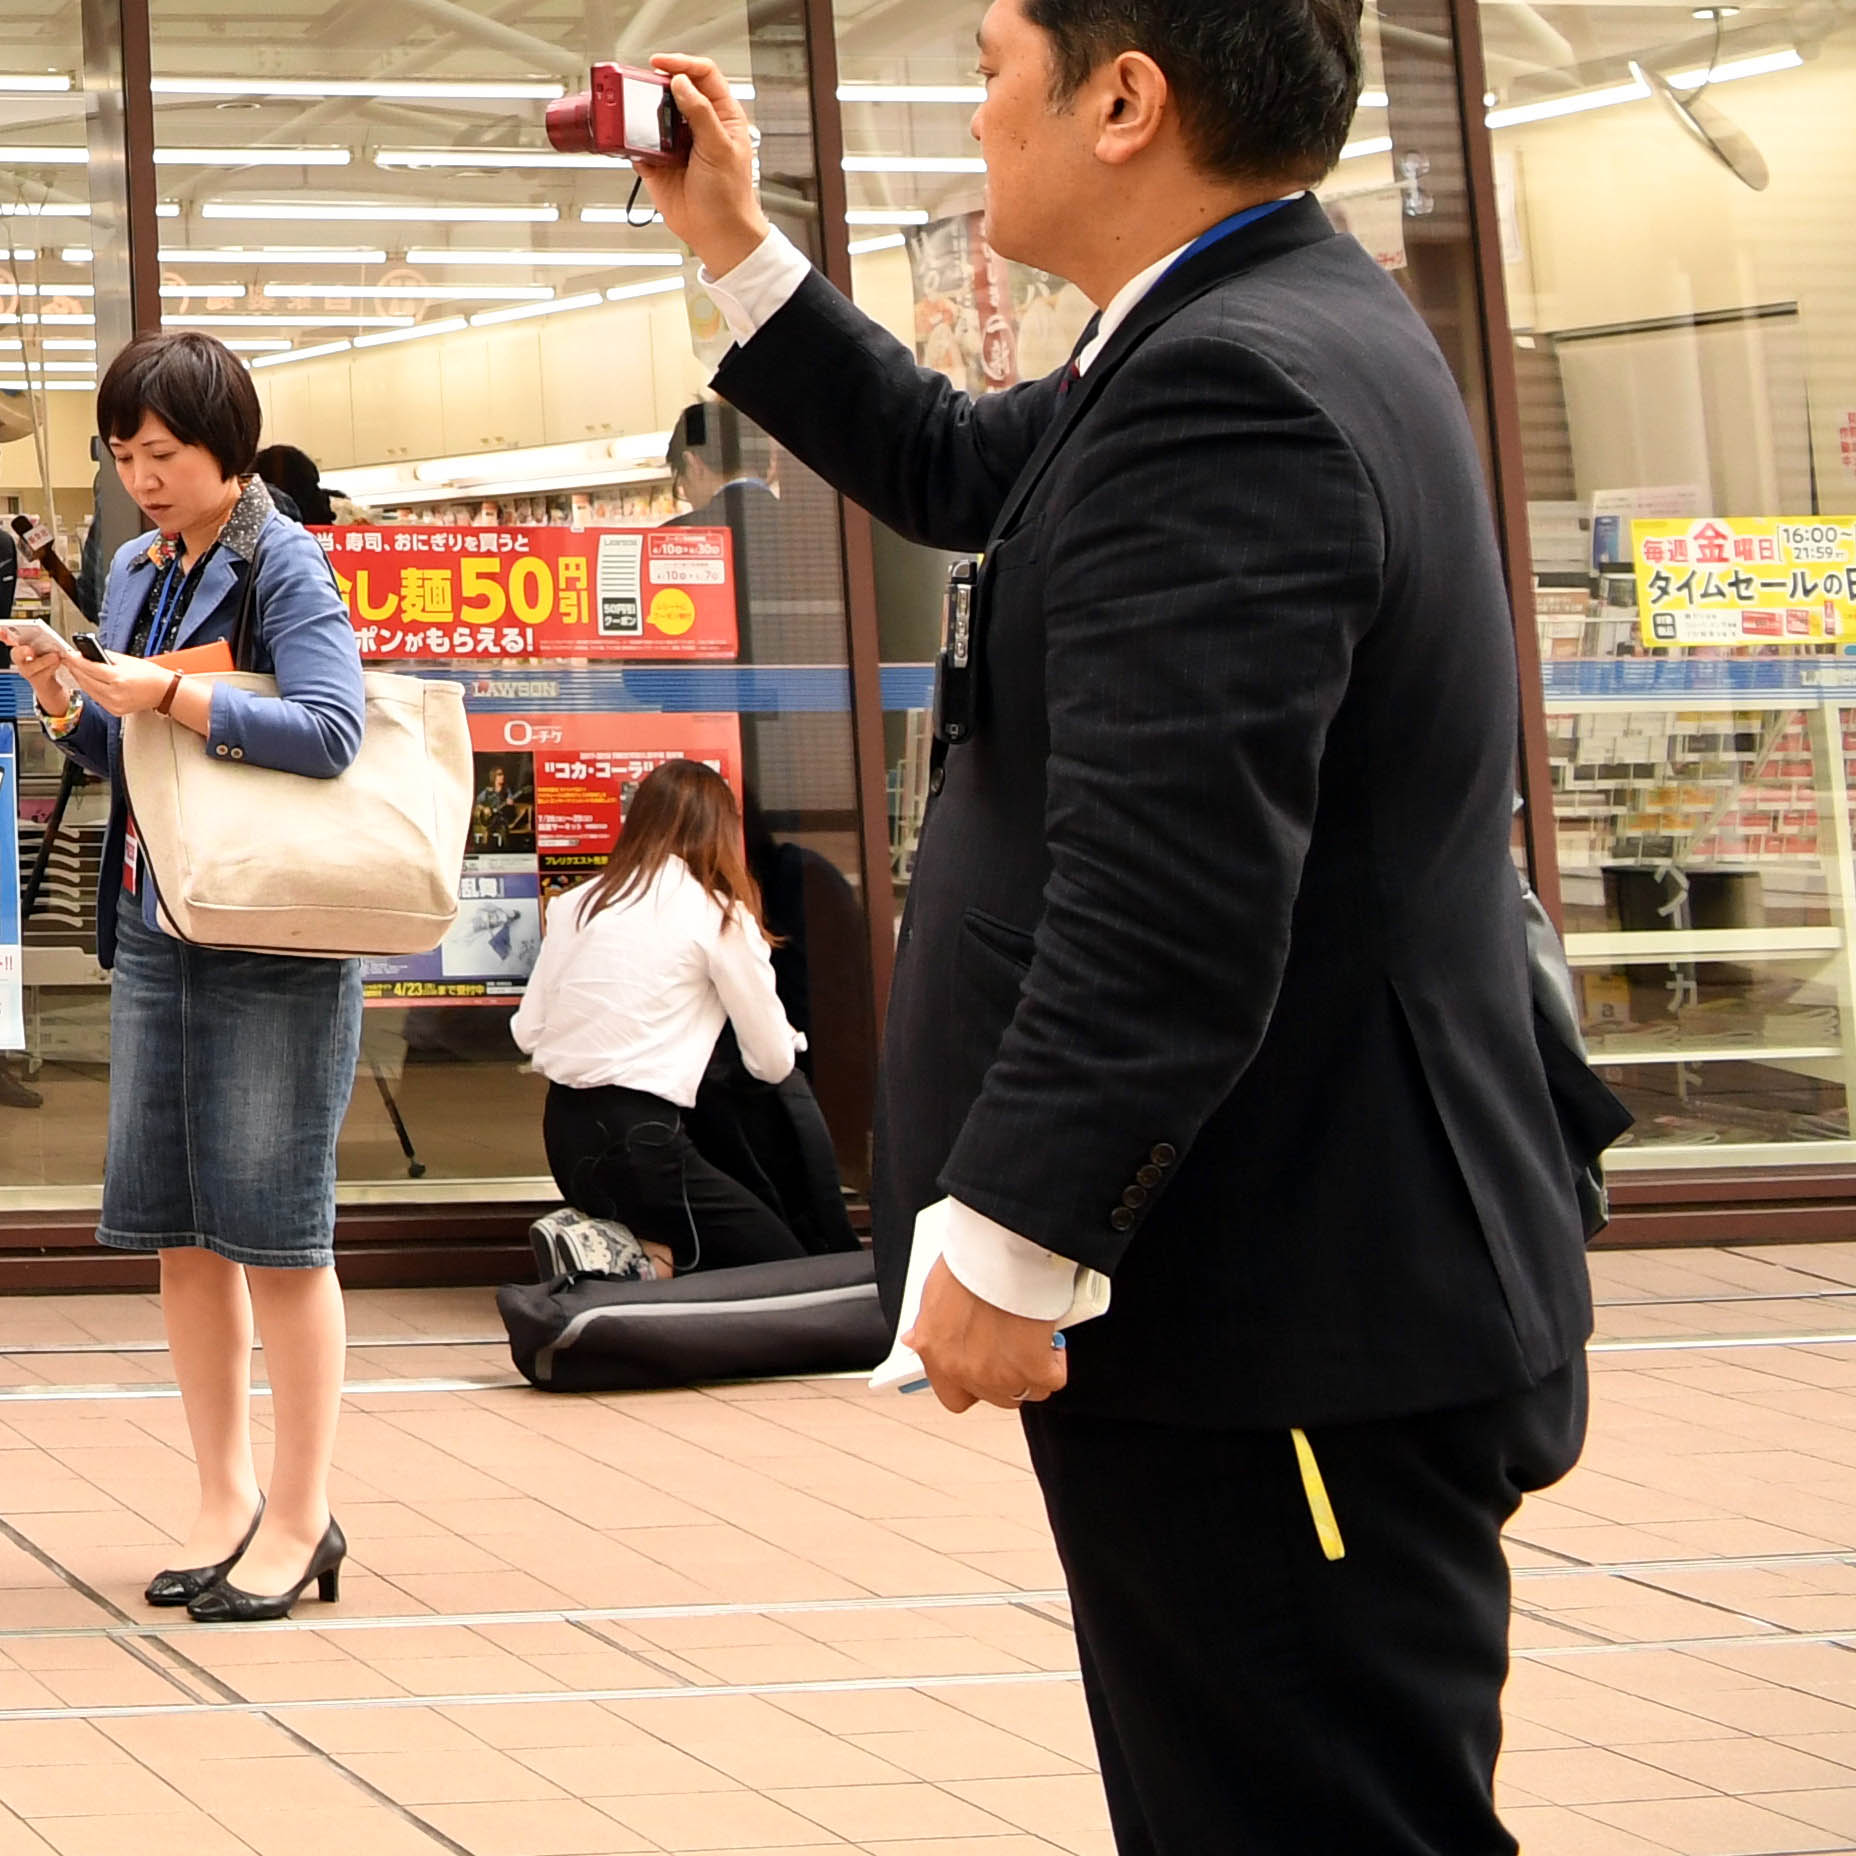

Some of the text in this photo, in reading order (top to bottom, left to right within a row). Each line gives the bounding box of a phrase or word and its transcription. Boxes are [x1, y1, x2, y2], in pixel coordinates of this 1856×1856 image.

[1644, 522, 1775, 564] 毎週金曜日
[472, 681, 558, 698] LAWSON
